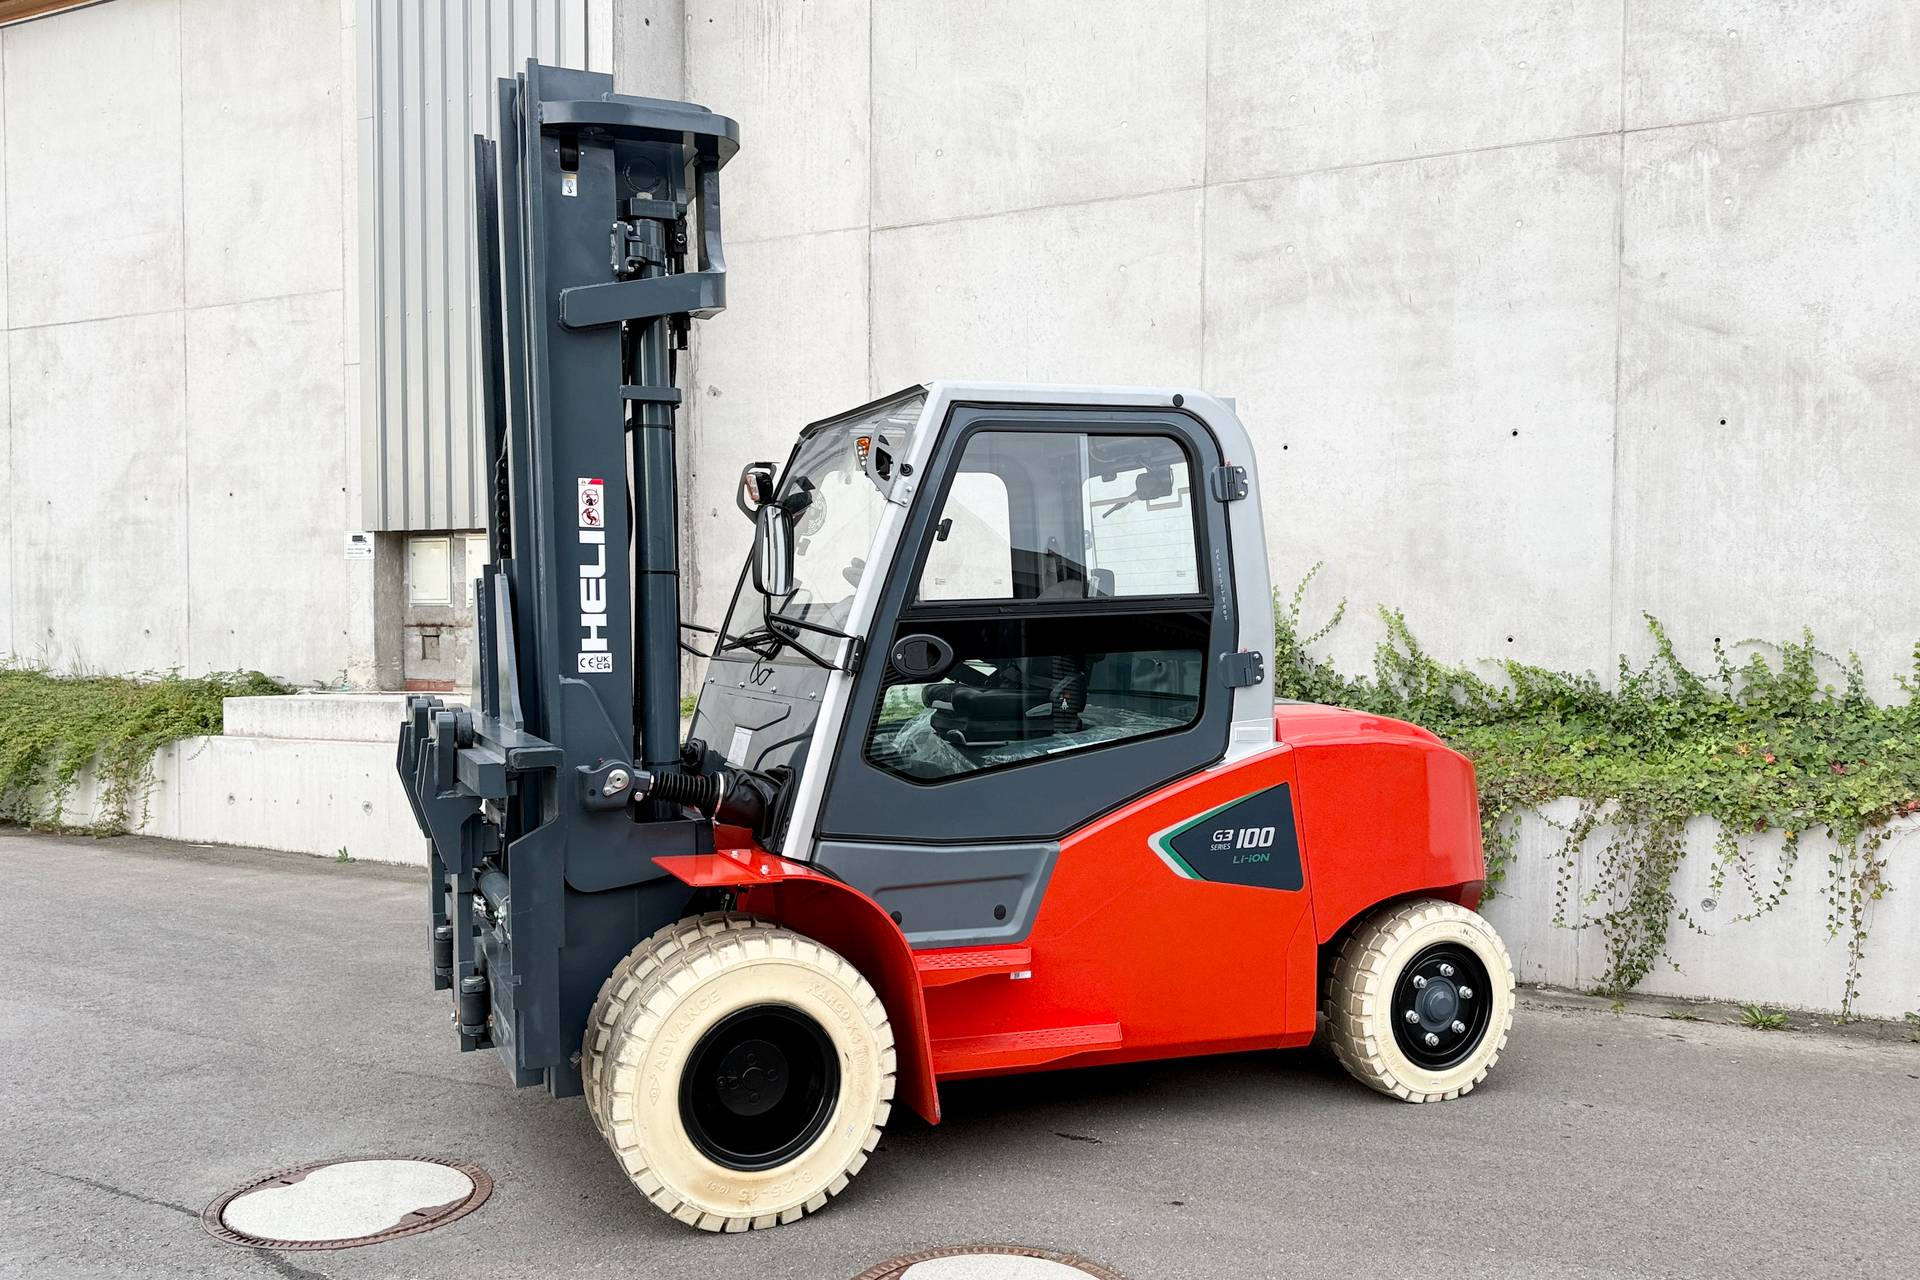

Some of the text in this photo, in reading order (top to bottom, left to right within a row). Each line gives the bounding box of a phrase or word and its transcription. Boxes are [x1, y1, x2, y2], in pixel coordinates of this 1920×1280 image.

[579, 531, 608, 651] HELI
[580, 658, 594, 668] CE
[1210, 843, 1231, 851] SERIES
[1213, 827, 1275, 849] G3 100
[656, 988, 722, 1072] ADVANCE
